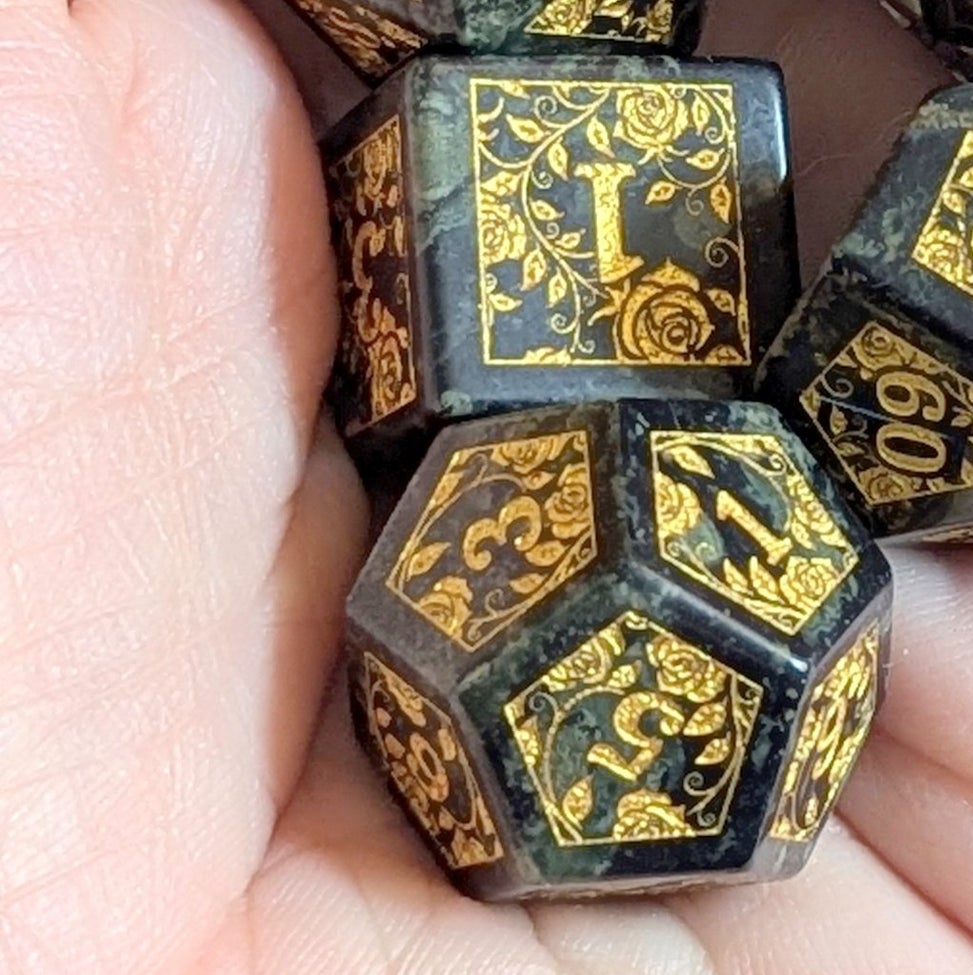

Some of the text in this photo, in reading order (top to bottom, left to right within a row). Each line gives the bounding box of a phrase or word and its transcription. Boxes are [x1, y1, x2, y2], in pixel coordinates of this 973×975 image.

[574, 162, 645, 284] 1
[462, 495, 543, 572] 3
[716, 490, 793, 564] 1
[587, 691, 685, 780] 5
